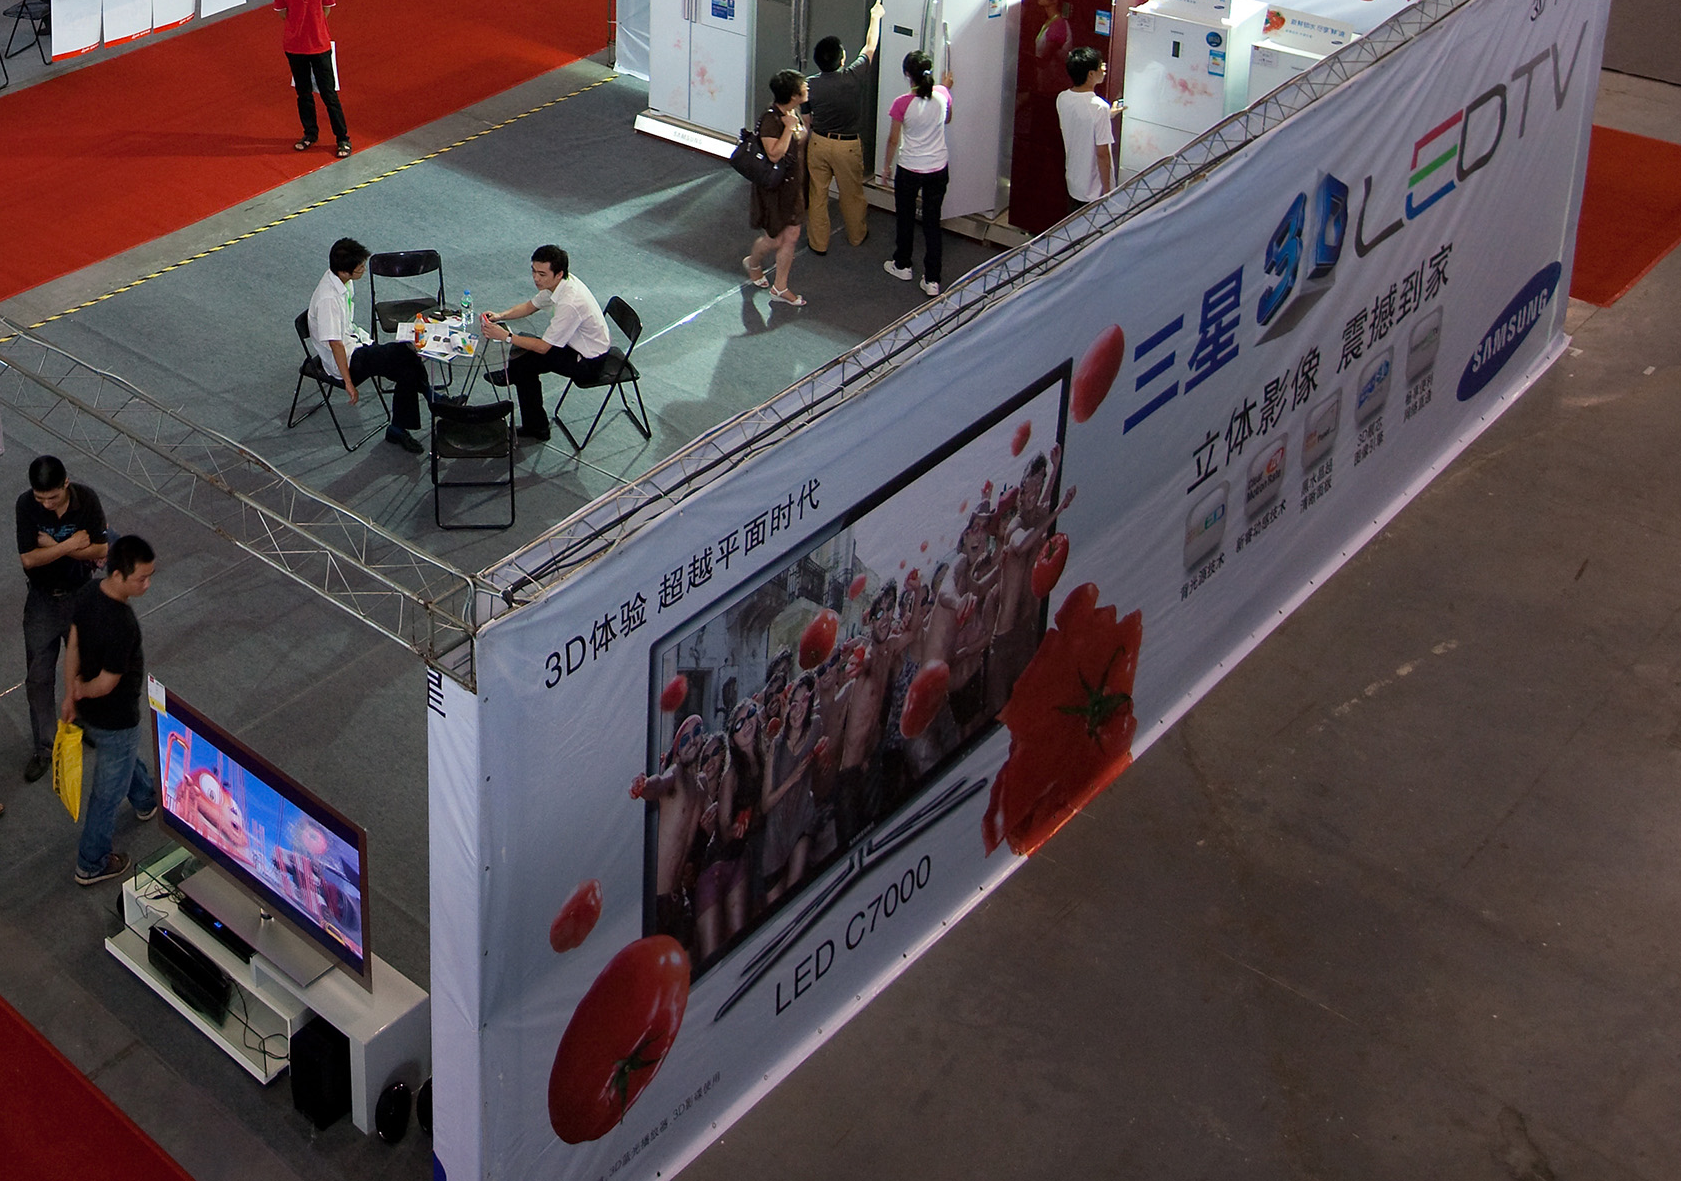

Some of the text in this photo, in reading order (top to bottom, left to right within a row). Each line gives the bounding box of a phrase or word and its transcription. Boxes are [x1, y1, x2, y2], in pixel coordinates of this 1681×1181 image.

[1122, 173, 1349, 436] 三星 3D
[1187, 242, 1453, 495] 立体影像 震撼到家
[1470, 288, 1548, 372] SAMSUNG
[544, 476, 821, 691] 3D体验 超越平面时代
[1179, 552, 1225, 602] 背光源技术
[774, 853, 932, 1016] LED C7000
